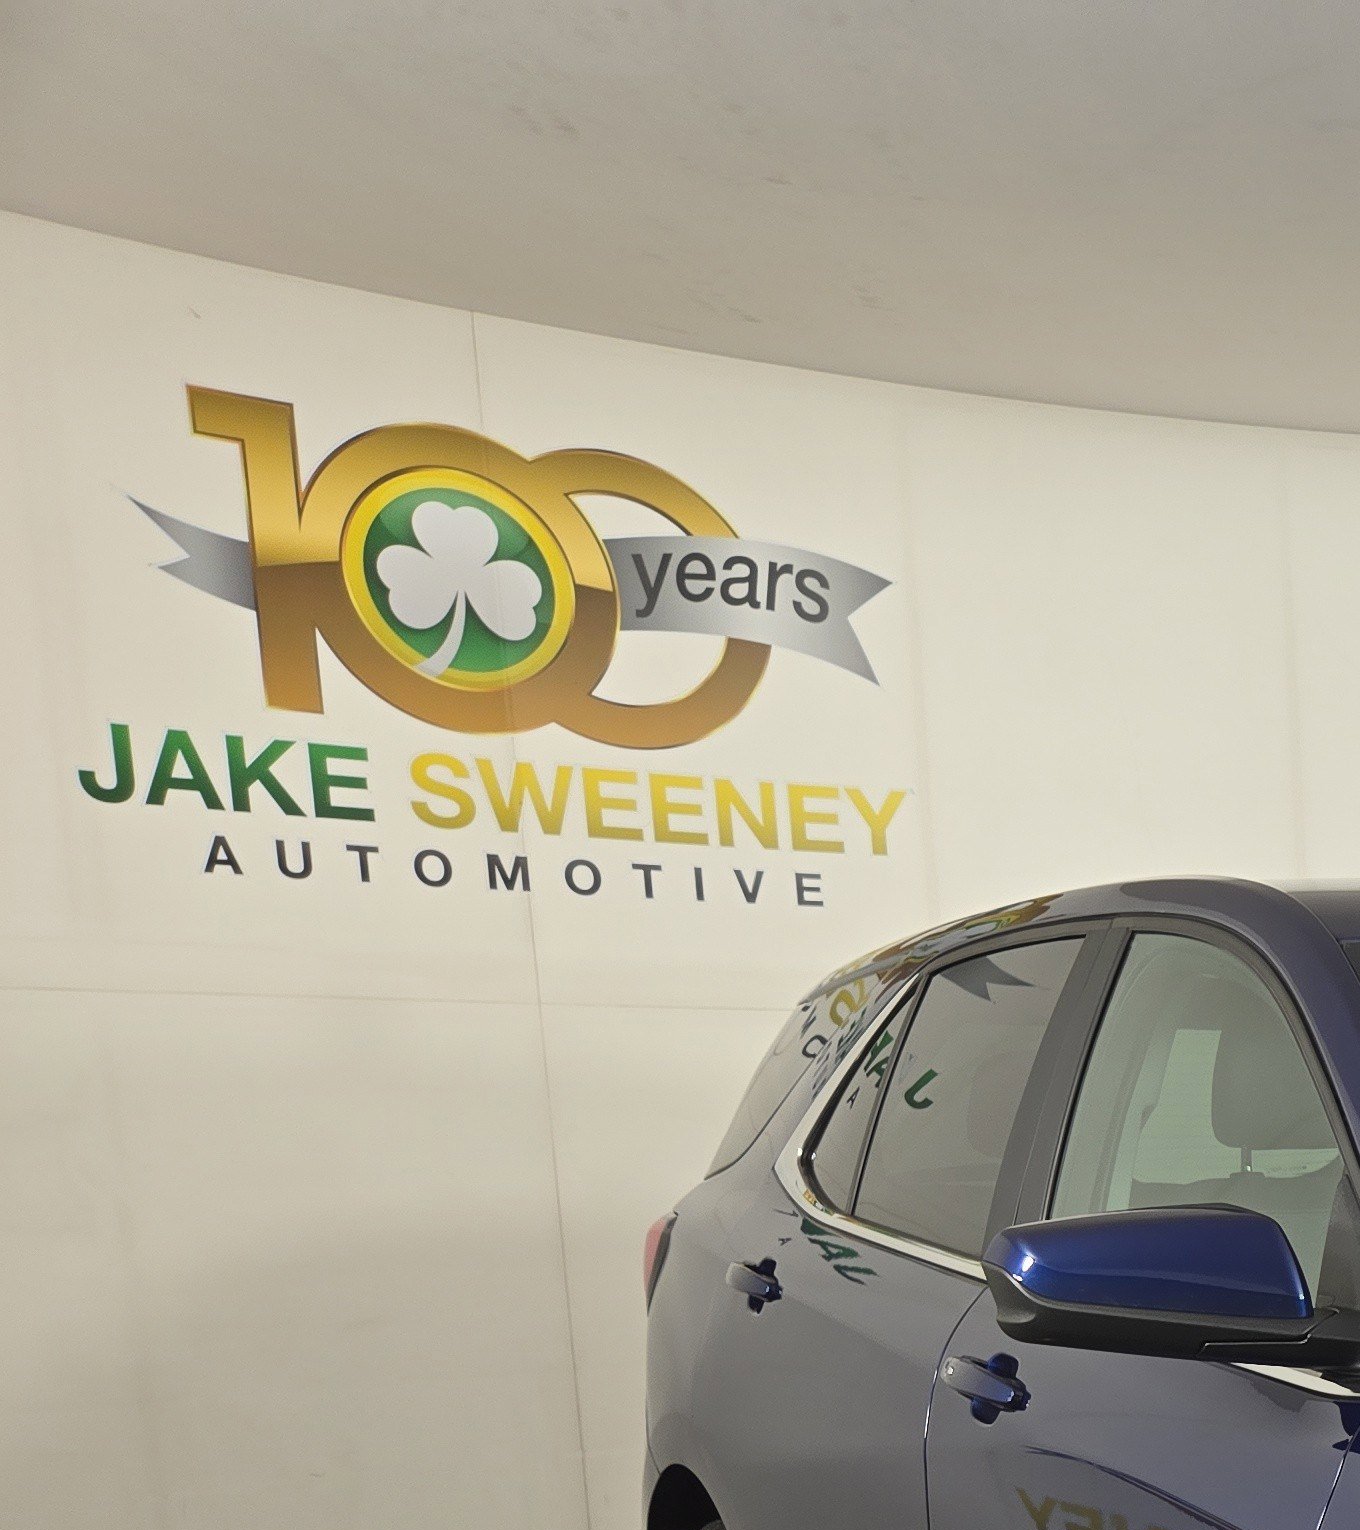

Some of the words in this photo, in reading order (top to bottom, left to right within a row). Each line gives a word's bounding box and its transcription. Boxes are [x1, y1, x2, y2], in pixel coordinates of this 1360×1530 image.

[186, 384, 772, 749] 100
[631, 545, 831, 624] years
[78, 723, 377, 822] JAKE
[409, 752, 906, 857] SWEENEY
[204, 835, 826, 907] AUTOMOTIVE
